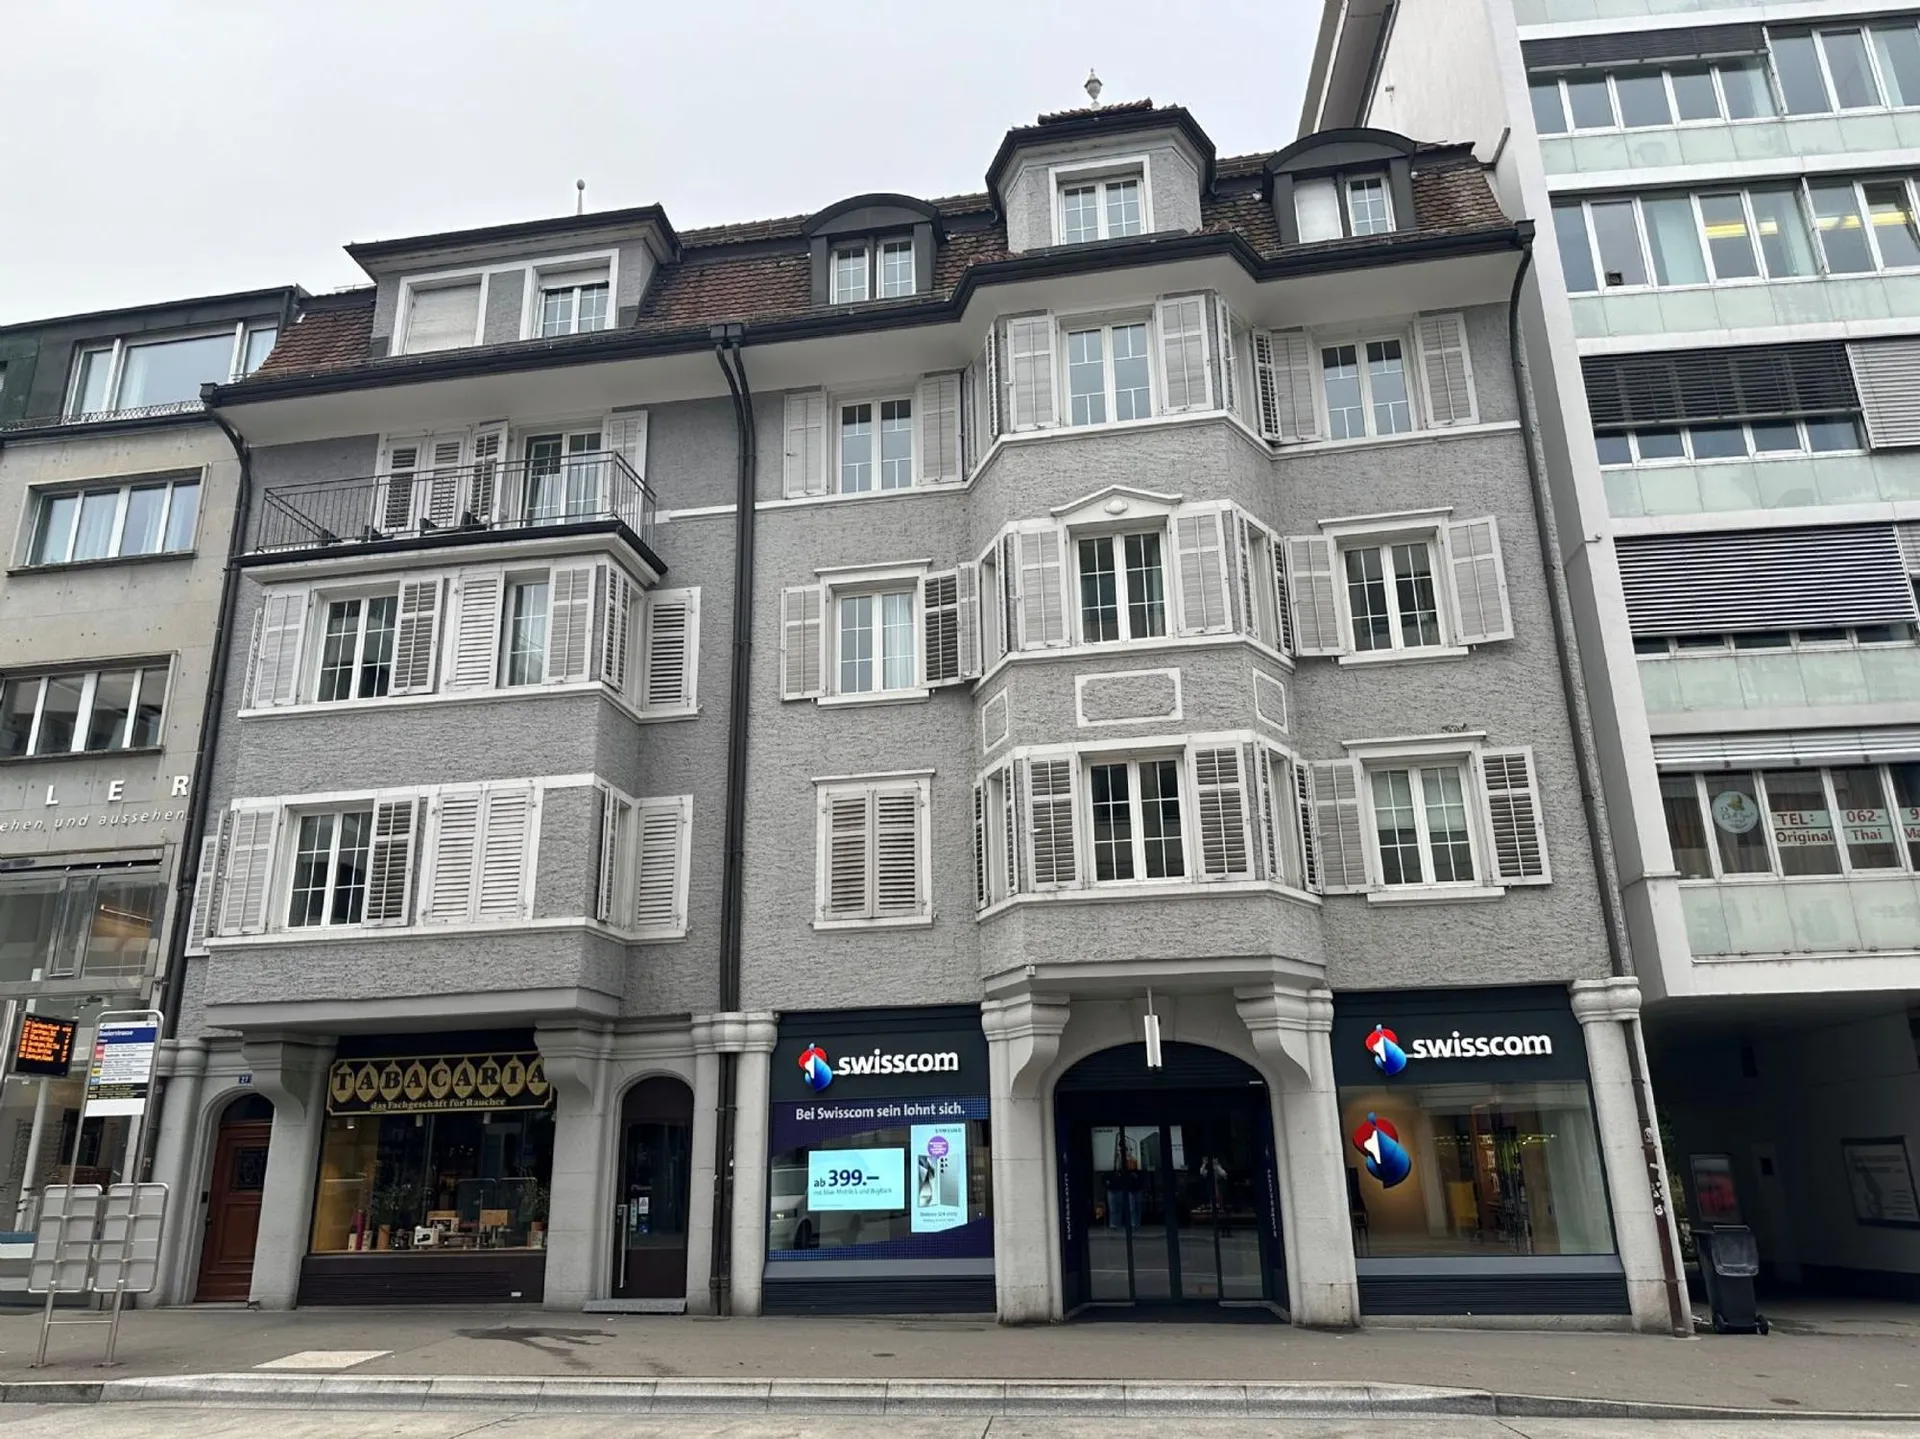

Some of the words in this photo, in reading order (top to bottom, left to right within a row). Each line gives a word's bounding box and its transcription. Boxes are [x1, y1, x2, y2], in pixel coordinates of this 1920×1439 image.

[54, 813, 90, 829] und
[99, 808, 187, 826] aussehen
[1776, 829, 1833, 845] Original
[1851, 828, 1883, 840] Thai
[1412, 1030, 1552, 1059] swisscom
[838, 1048, 959, 1076] swisscom
[336, 1063, 549, 1091] TABACARIA
[449, 1098, 464, 1107] für
[796, 1107, 814, 1120] Bei
[817, 1106, 874, 1119] Swisscom
[876, 1104, 901, 1117] sein
[904, 1103, 936, 1117] lohnt
[939, 1101, 965, 1115] sich.
[813, 1177, 826, 1187] ab
